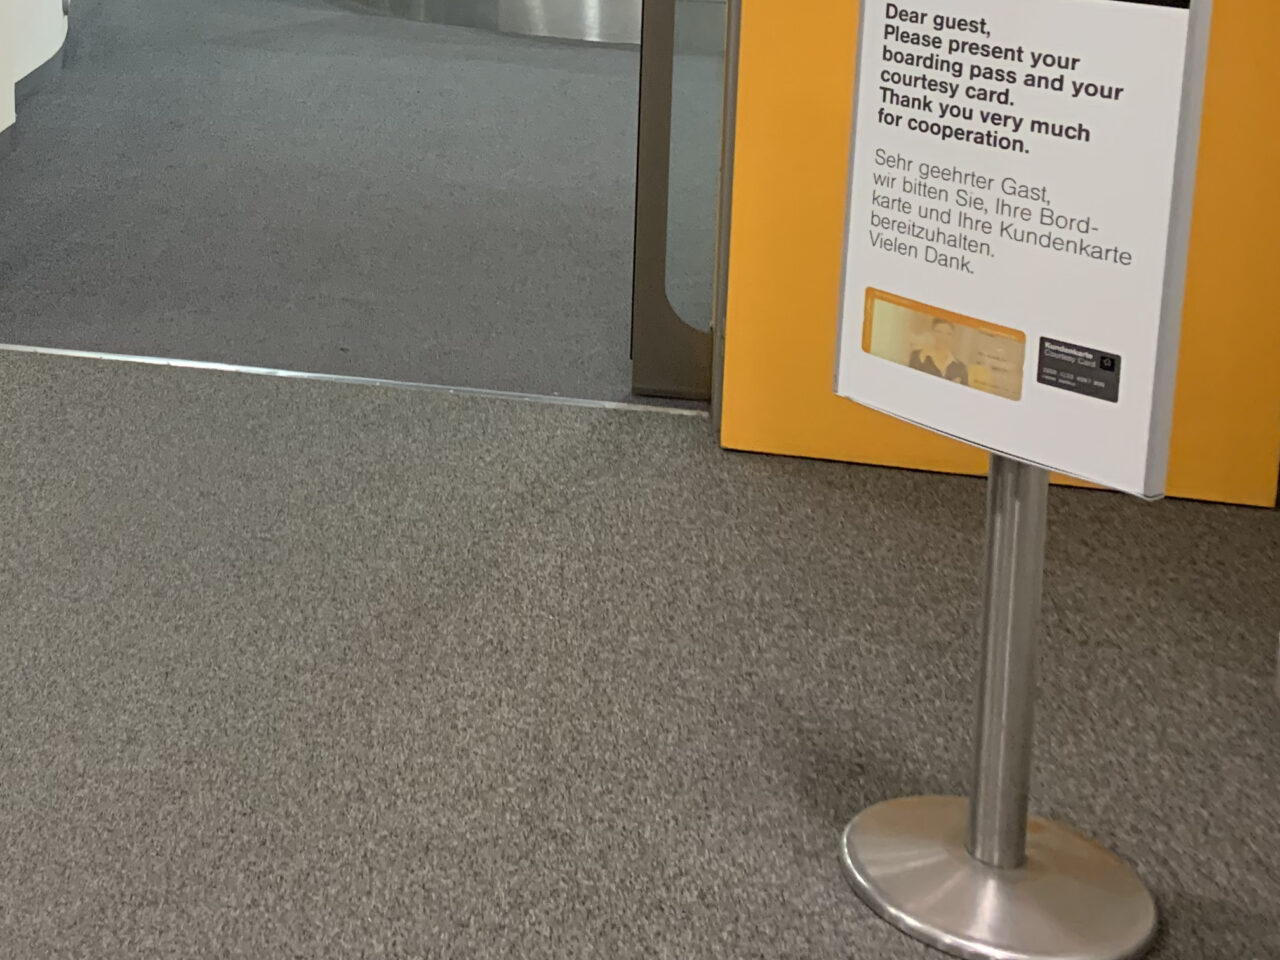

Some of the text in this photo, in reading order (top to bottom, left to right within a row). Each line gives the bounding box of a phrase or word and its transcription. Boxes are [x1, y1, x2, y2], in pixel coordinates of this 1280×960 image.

[885, 3, 991, 38] Dear guest,
[884, 24, 1081, 71] Please present your
[880, 69, 1015, 106] courtesy card.
[882, 45, 1124, 101] boarding pass and your
[877, 108, 1030, 154] for cooperation.
[879, 86, 1091, 142] Thank you very much
[874, 148, 1051, 205] Sehr geehrter Gast,
[873, 172, 1099, 234] wir bitten Sie, Ihre Bord-
[869, 230, 974, 274] Vielen Dank.
[870, 210, 995, 258] bereitzuhalten.
[872, 190, 1133, 266] karte und Ihre Kundenkarte
